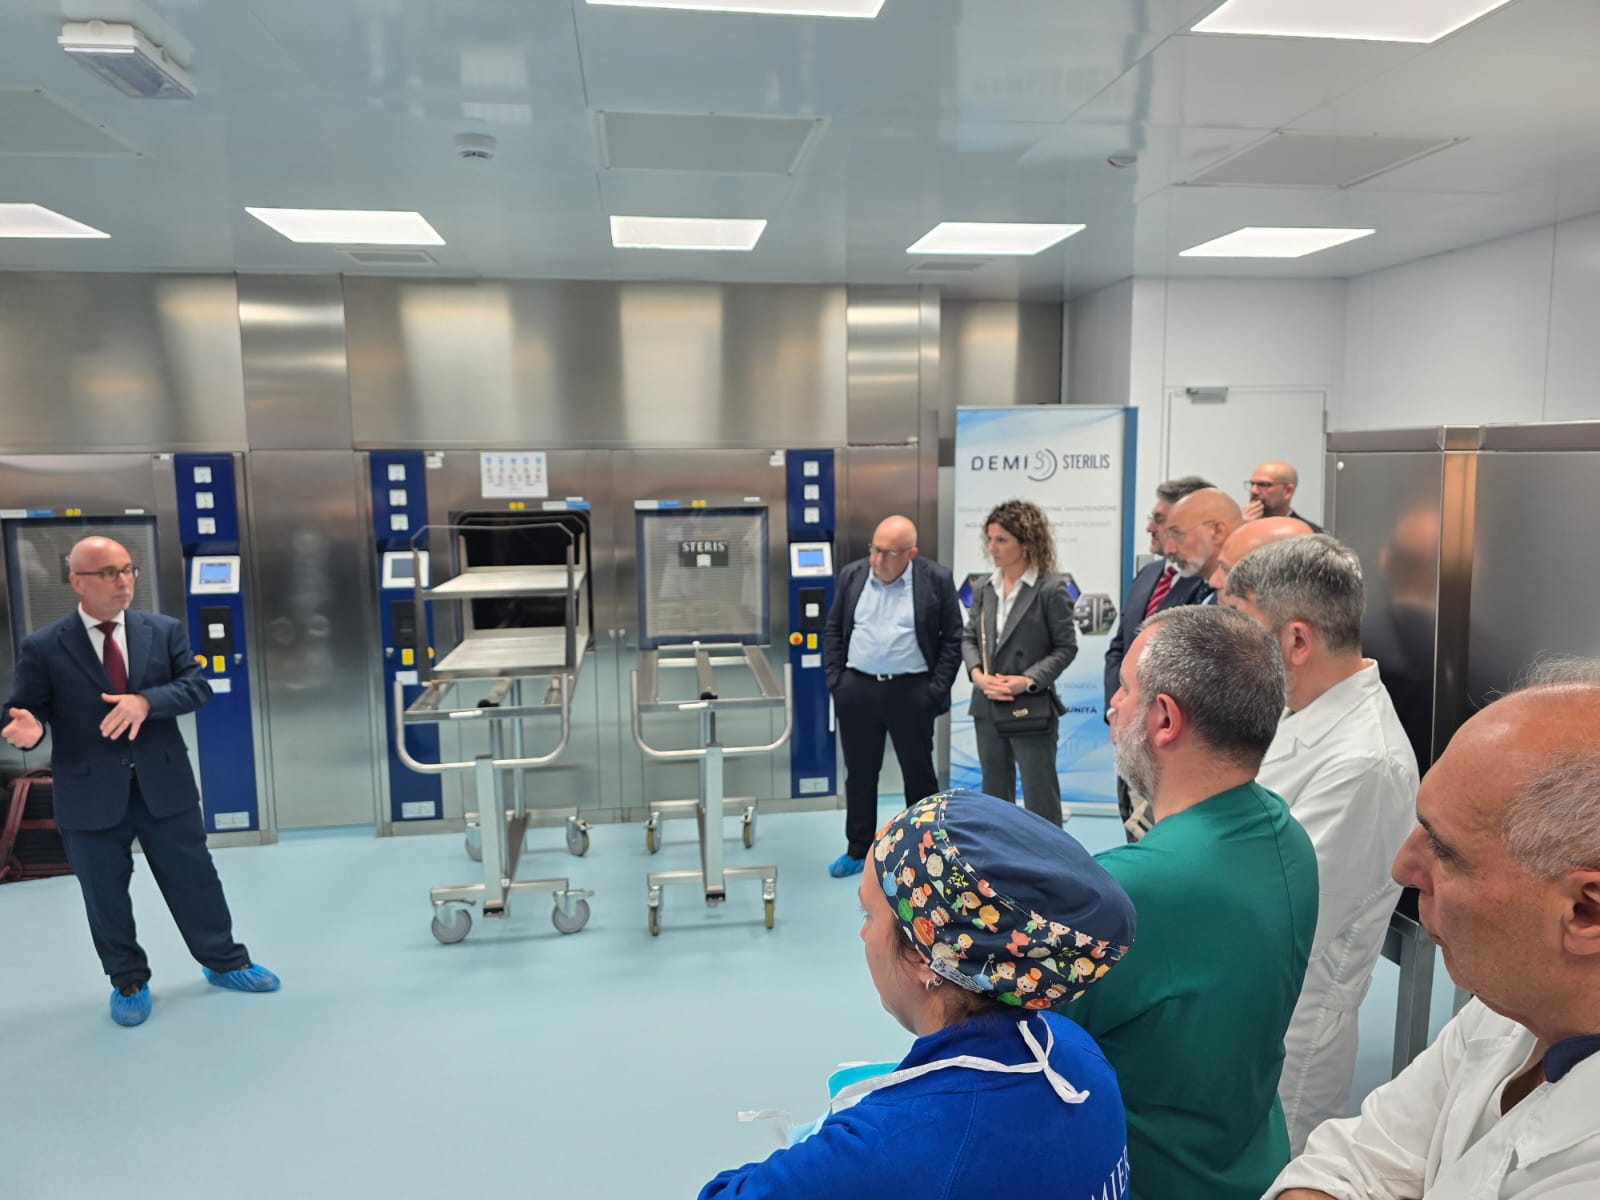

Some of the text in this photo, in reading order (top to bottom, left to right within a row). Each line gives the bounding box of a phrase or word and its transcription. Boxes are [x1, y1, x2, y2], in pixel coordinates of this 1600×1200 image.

[971, 455, 1028, 471] DEMI
[1062, 454, 1110, 469] STERILIS
[682, 541, 725, 552] STERIS
